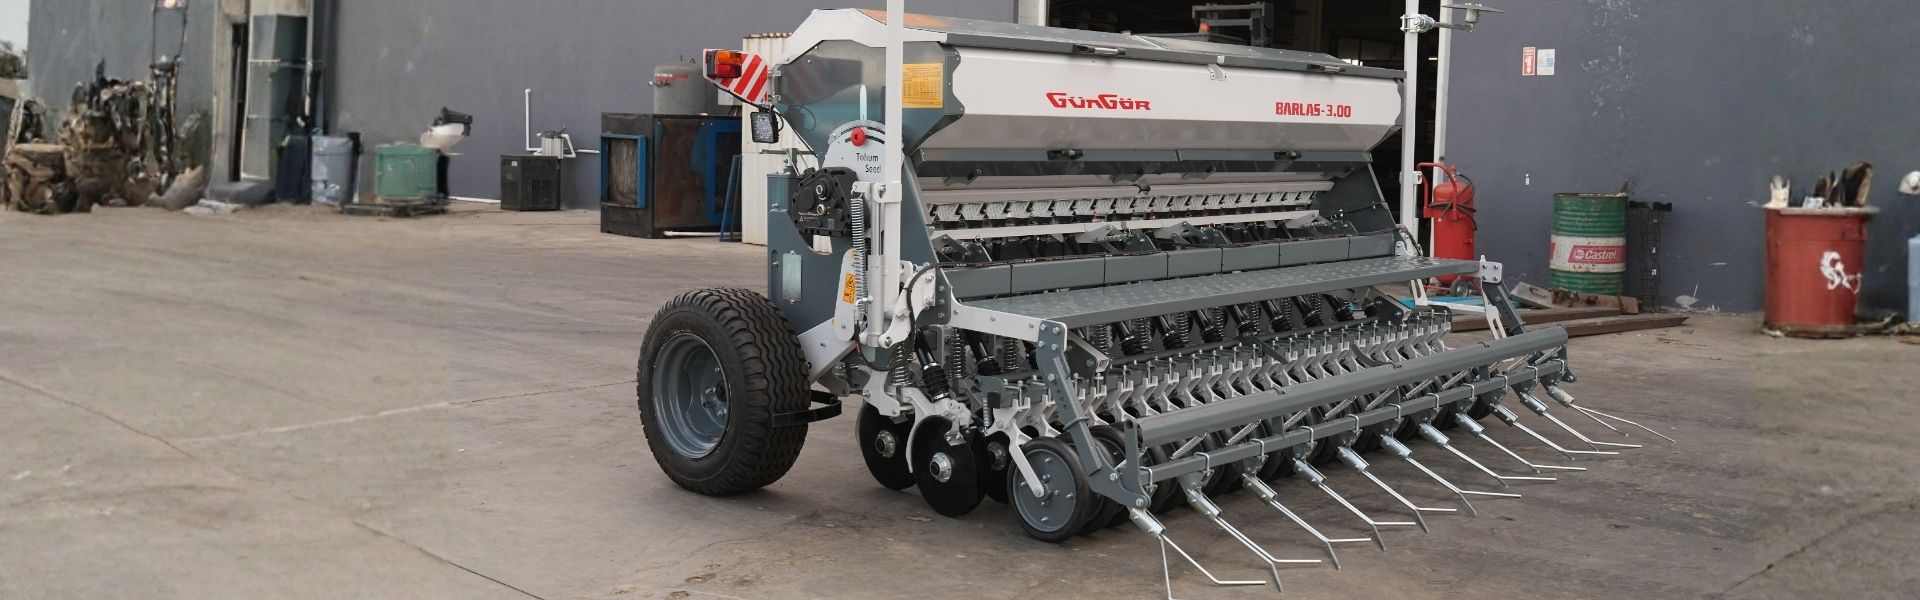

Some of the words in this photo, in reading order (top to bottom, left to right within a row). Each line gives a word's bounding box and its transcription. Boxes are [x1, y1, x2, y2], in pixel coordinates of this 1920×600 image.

[856, 152, 879, 162] Tohum
[865, 164, 881, 173] Seed
[1584, 249, 1617, 260] Castrol
